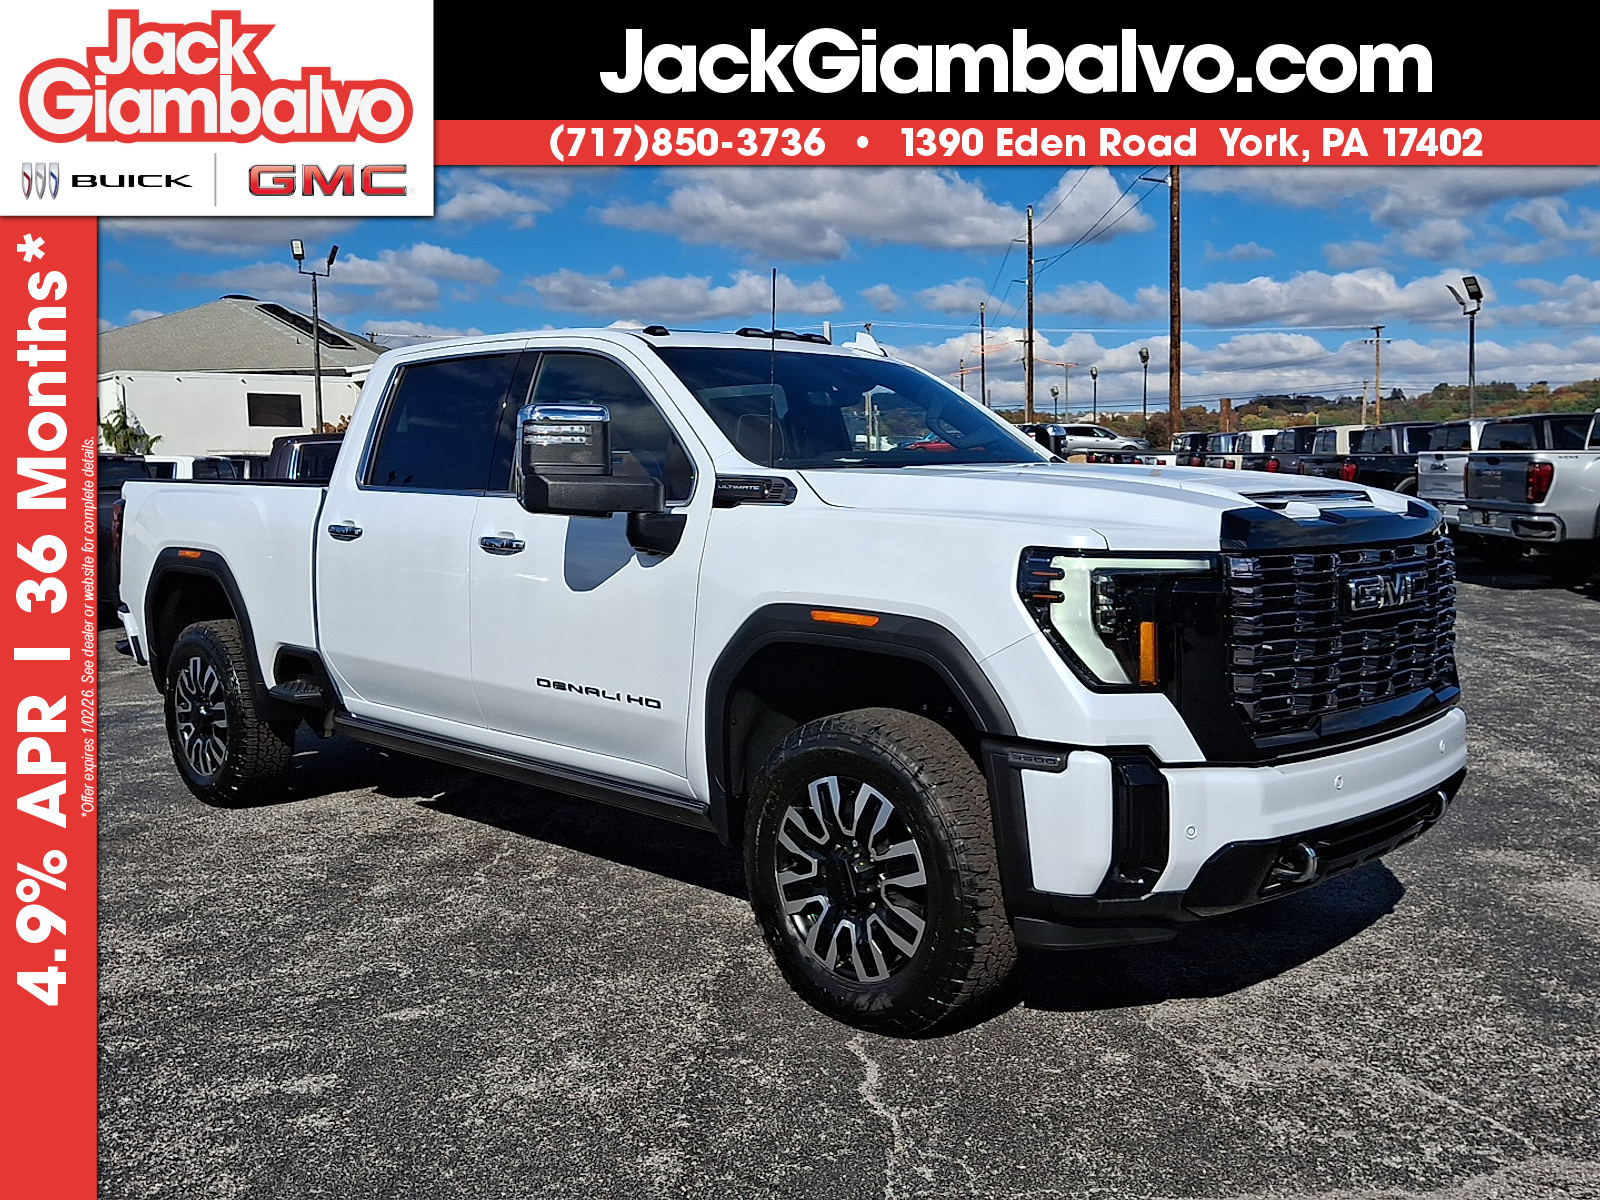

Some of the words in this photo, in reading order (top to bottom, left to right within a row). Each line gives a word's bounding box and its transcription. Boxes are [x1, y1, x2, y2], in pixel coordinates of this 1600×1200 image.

[1348, 571, 1428, 611] GMC
[536, 677, 621, 702] DENALI
[626, 694, 662, 709] HD
